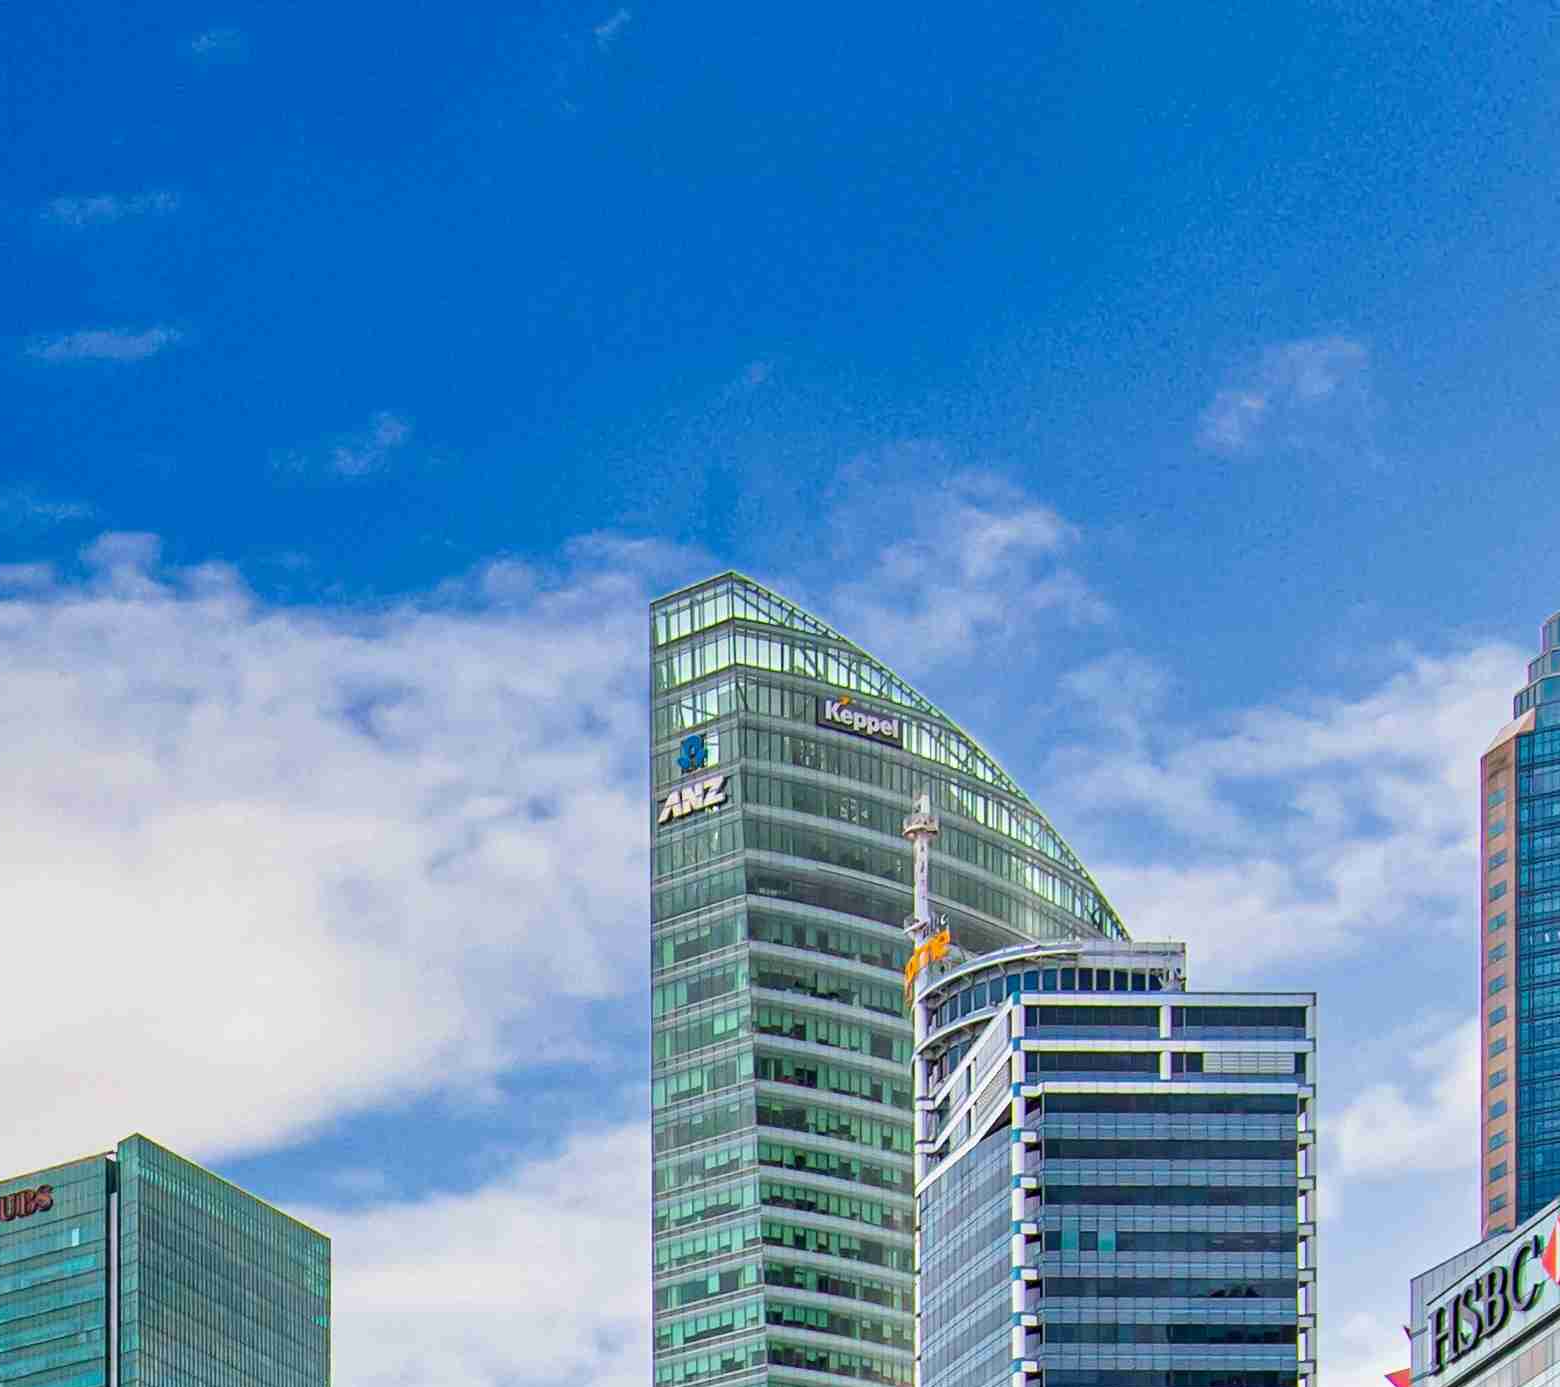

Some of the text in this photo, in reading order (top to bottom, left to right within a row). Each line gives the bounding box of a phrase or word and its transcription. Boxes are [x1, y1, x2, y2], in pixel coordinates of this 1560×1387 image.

[825, 699, 899, 739] Keppel
[658, 775, 726, 823] ANZ
[1428, 1234, 1547, 1376] HSBC
